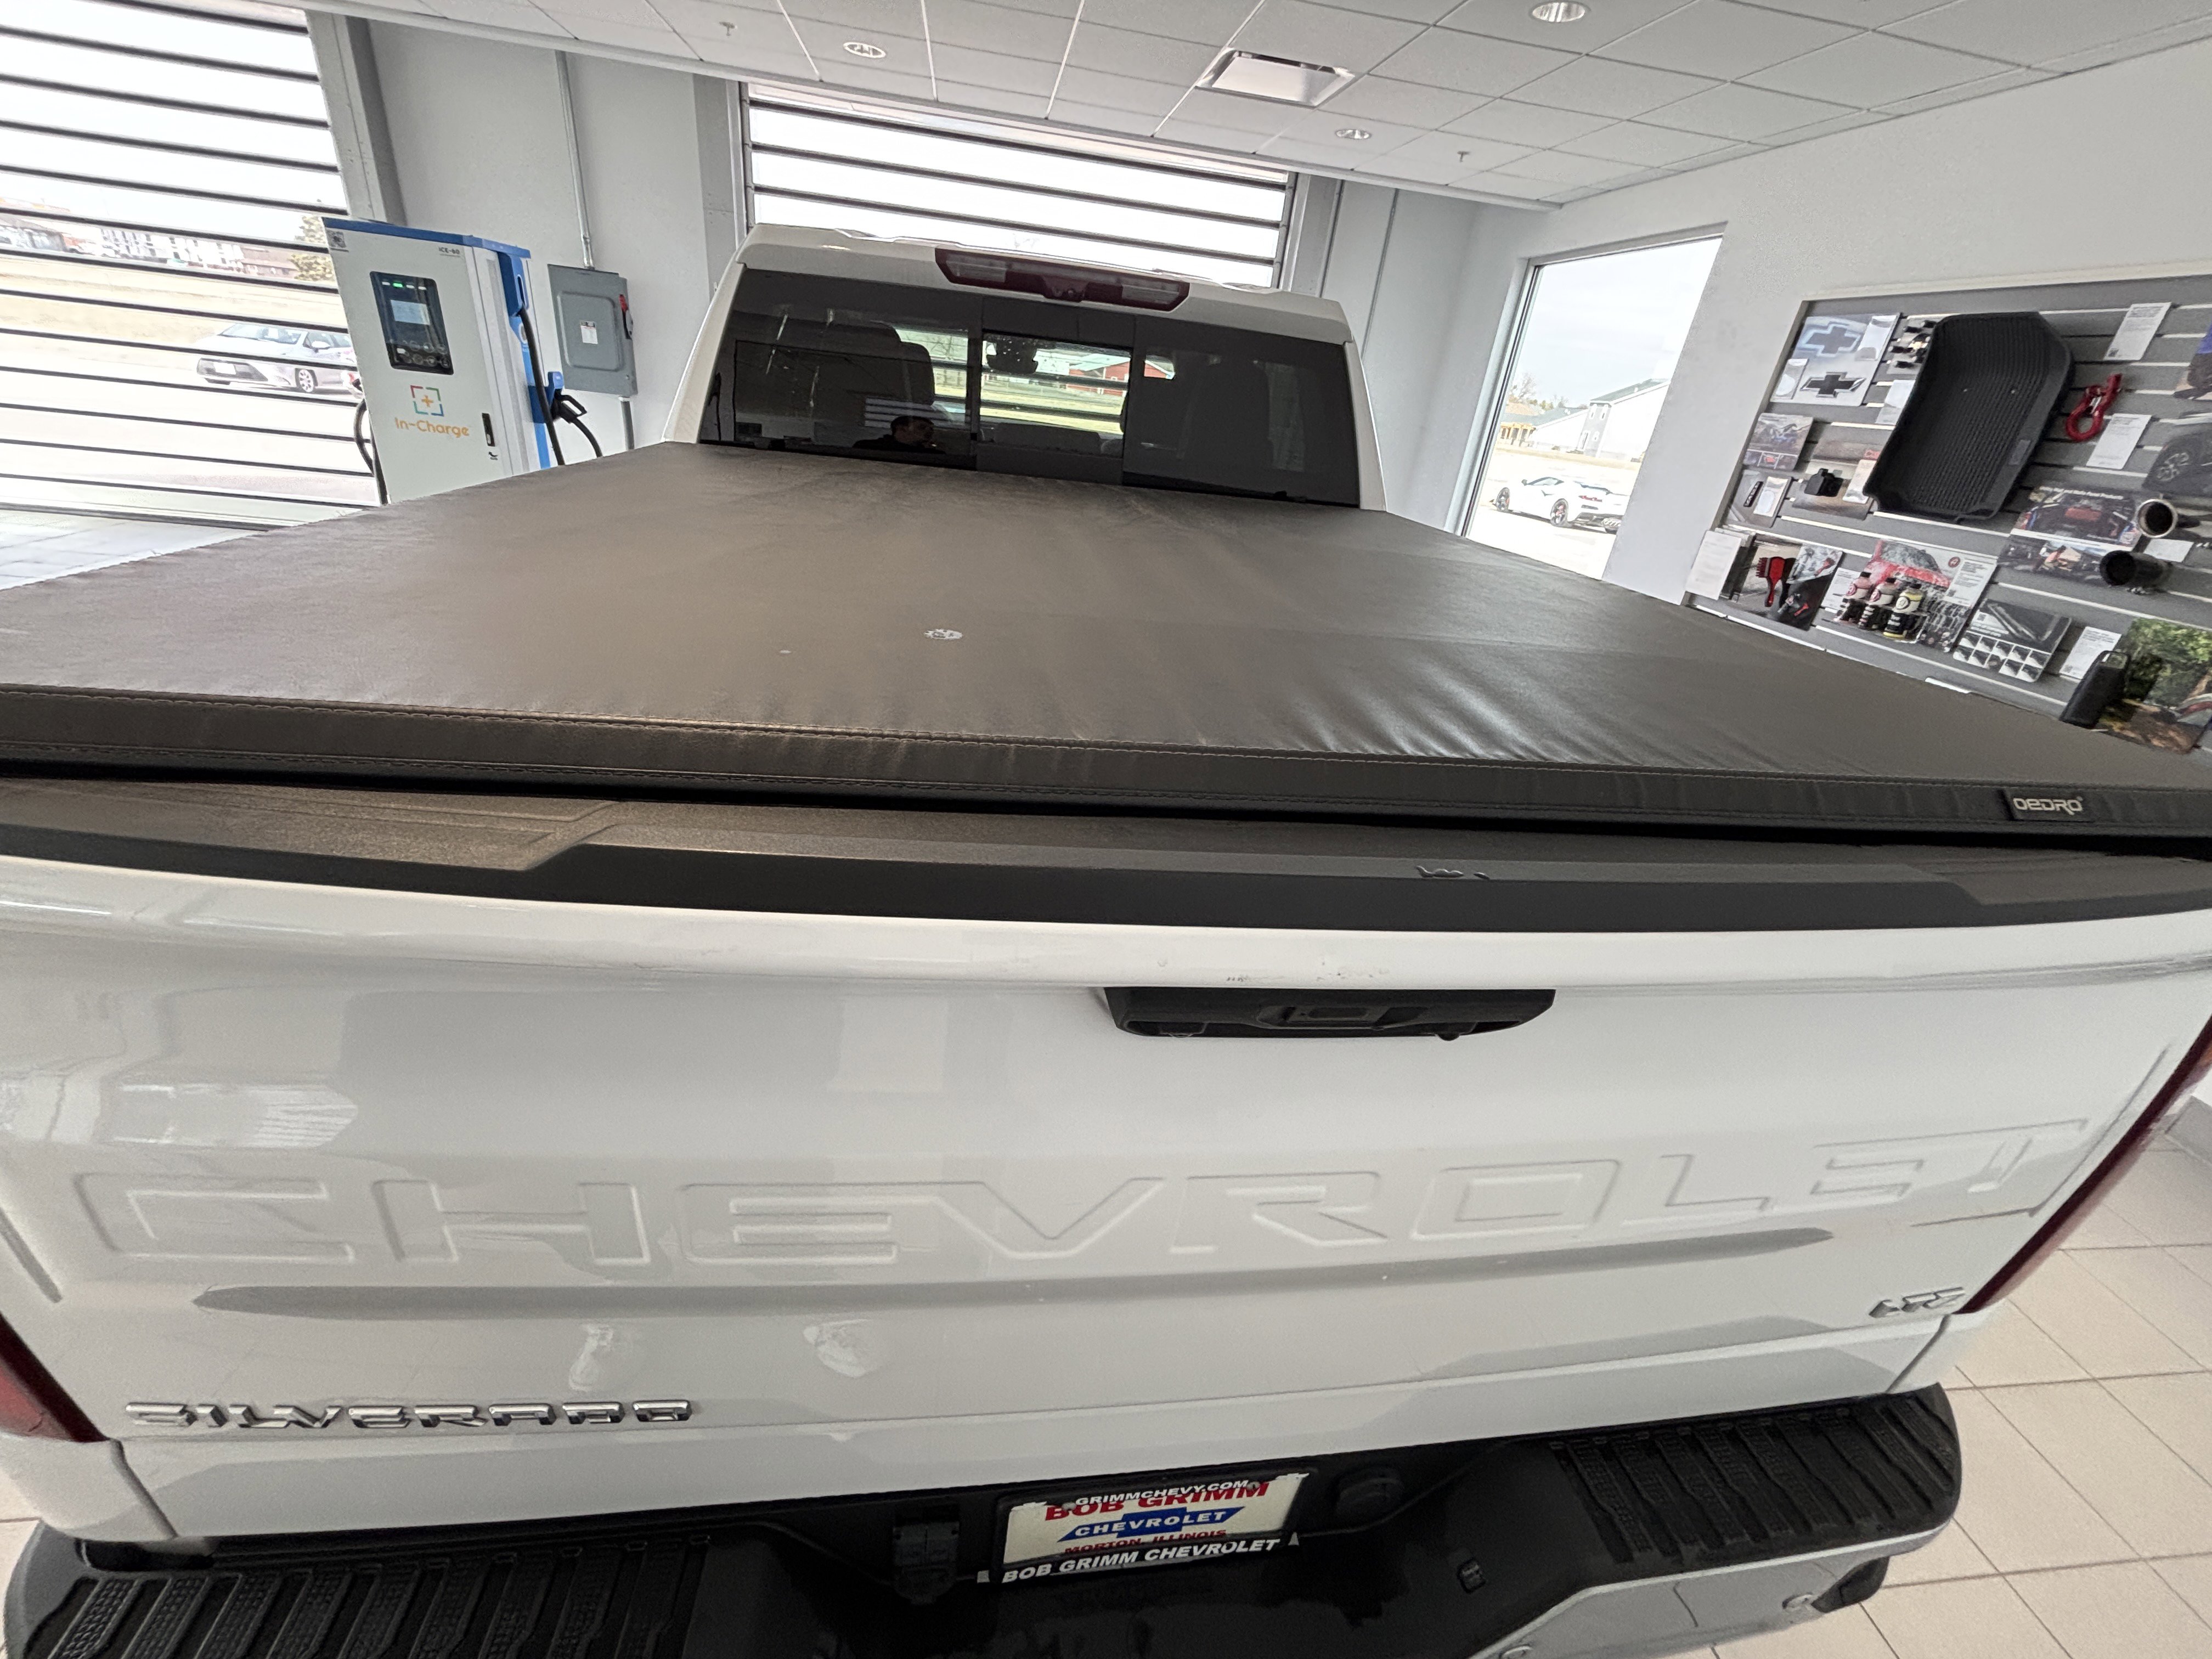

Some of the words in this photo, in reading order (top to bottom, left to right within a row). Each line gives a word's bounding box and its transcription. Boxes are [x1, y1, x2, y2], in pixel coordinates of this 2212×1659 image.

[394, 417, 470, 438] In-Charge
[74, 1118, 2088, 1265] CHEVROLET
[125, 1401, 691, 1429] SILVERADO
[1045, 1500, 1125, 1521] BOB
[1137, 1482, 1269, 1509] GRIMM
[1076, 1480, 1249, 1505] GRIMMCHEVY.COM
[1075, 1510, 1227, 1537] CHEVROLET
[1002, 1564, 1051, 1583] BOB
[1059, 1550, 1138, 1573] GRIMM
[1144, 1538, 1280, 1561] CHEVROLET
